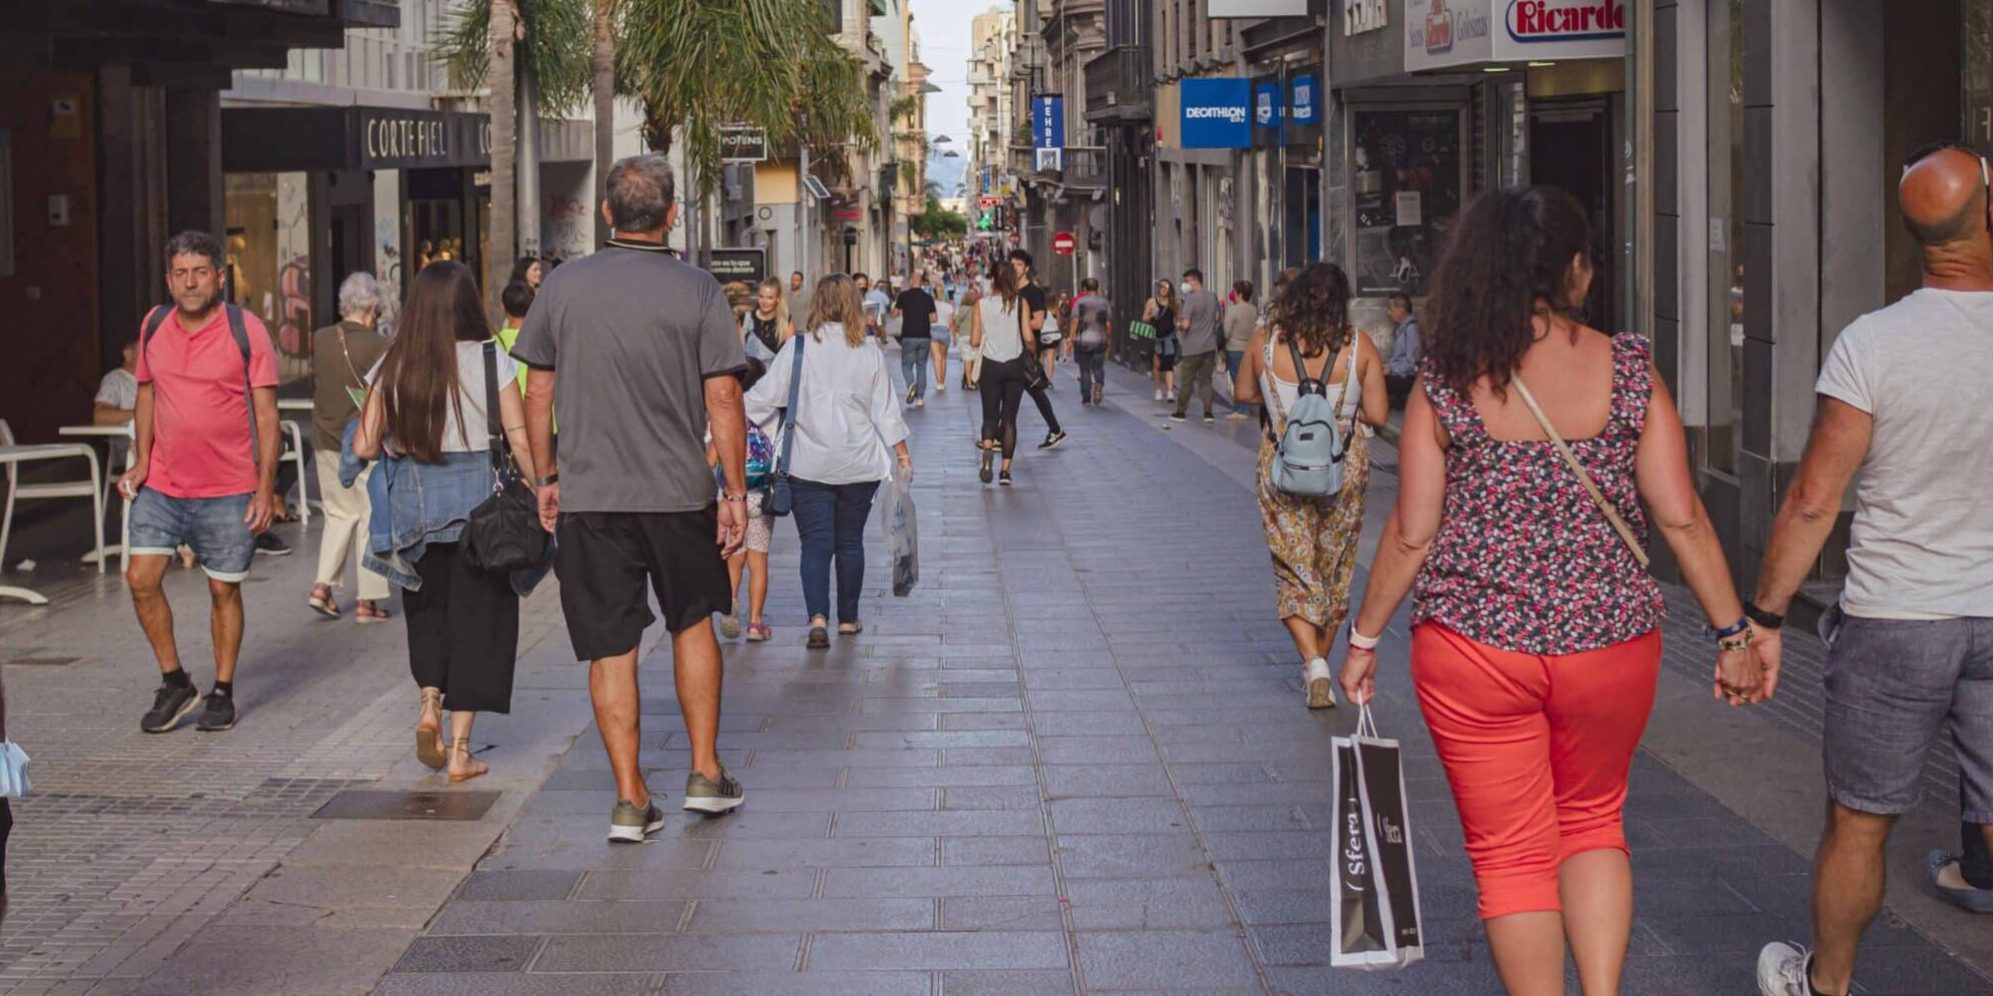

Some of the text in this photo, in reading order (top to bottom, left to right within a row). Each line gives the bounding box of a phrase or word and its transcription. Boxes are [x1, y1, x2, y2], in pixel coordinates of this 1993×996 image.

[1043, 96, 1052, 148] WEHBE
[1186, 106, 1246, 119] DECATHLON
[368, 119, 446, 158] CORTEFIEL
[1345, 812, 1365, 876] Sfera
